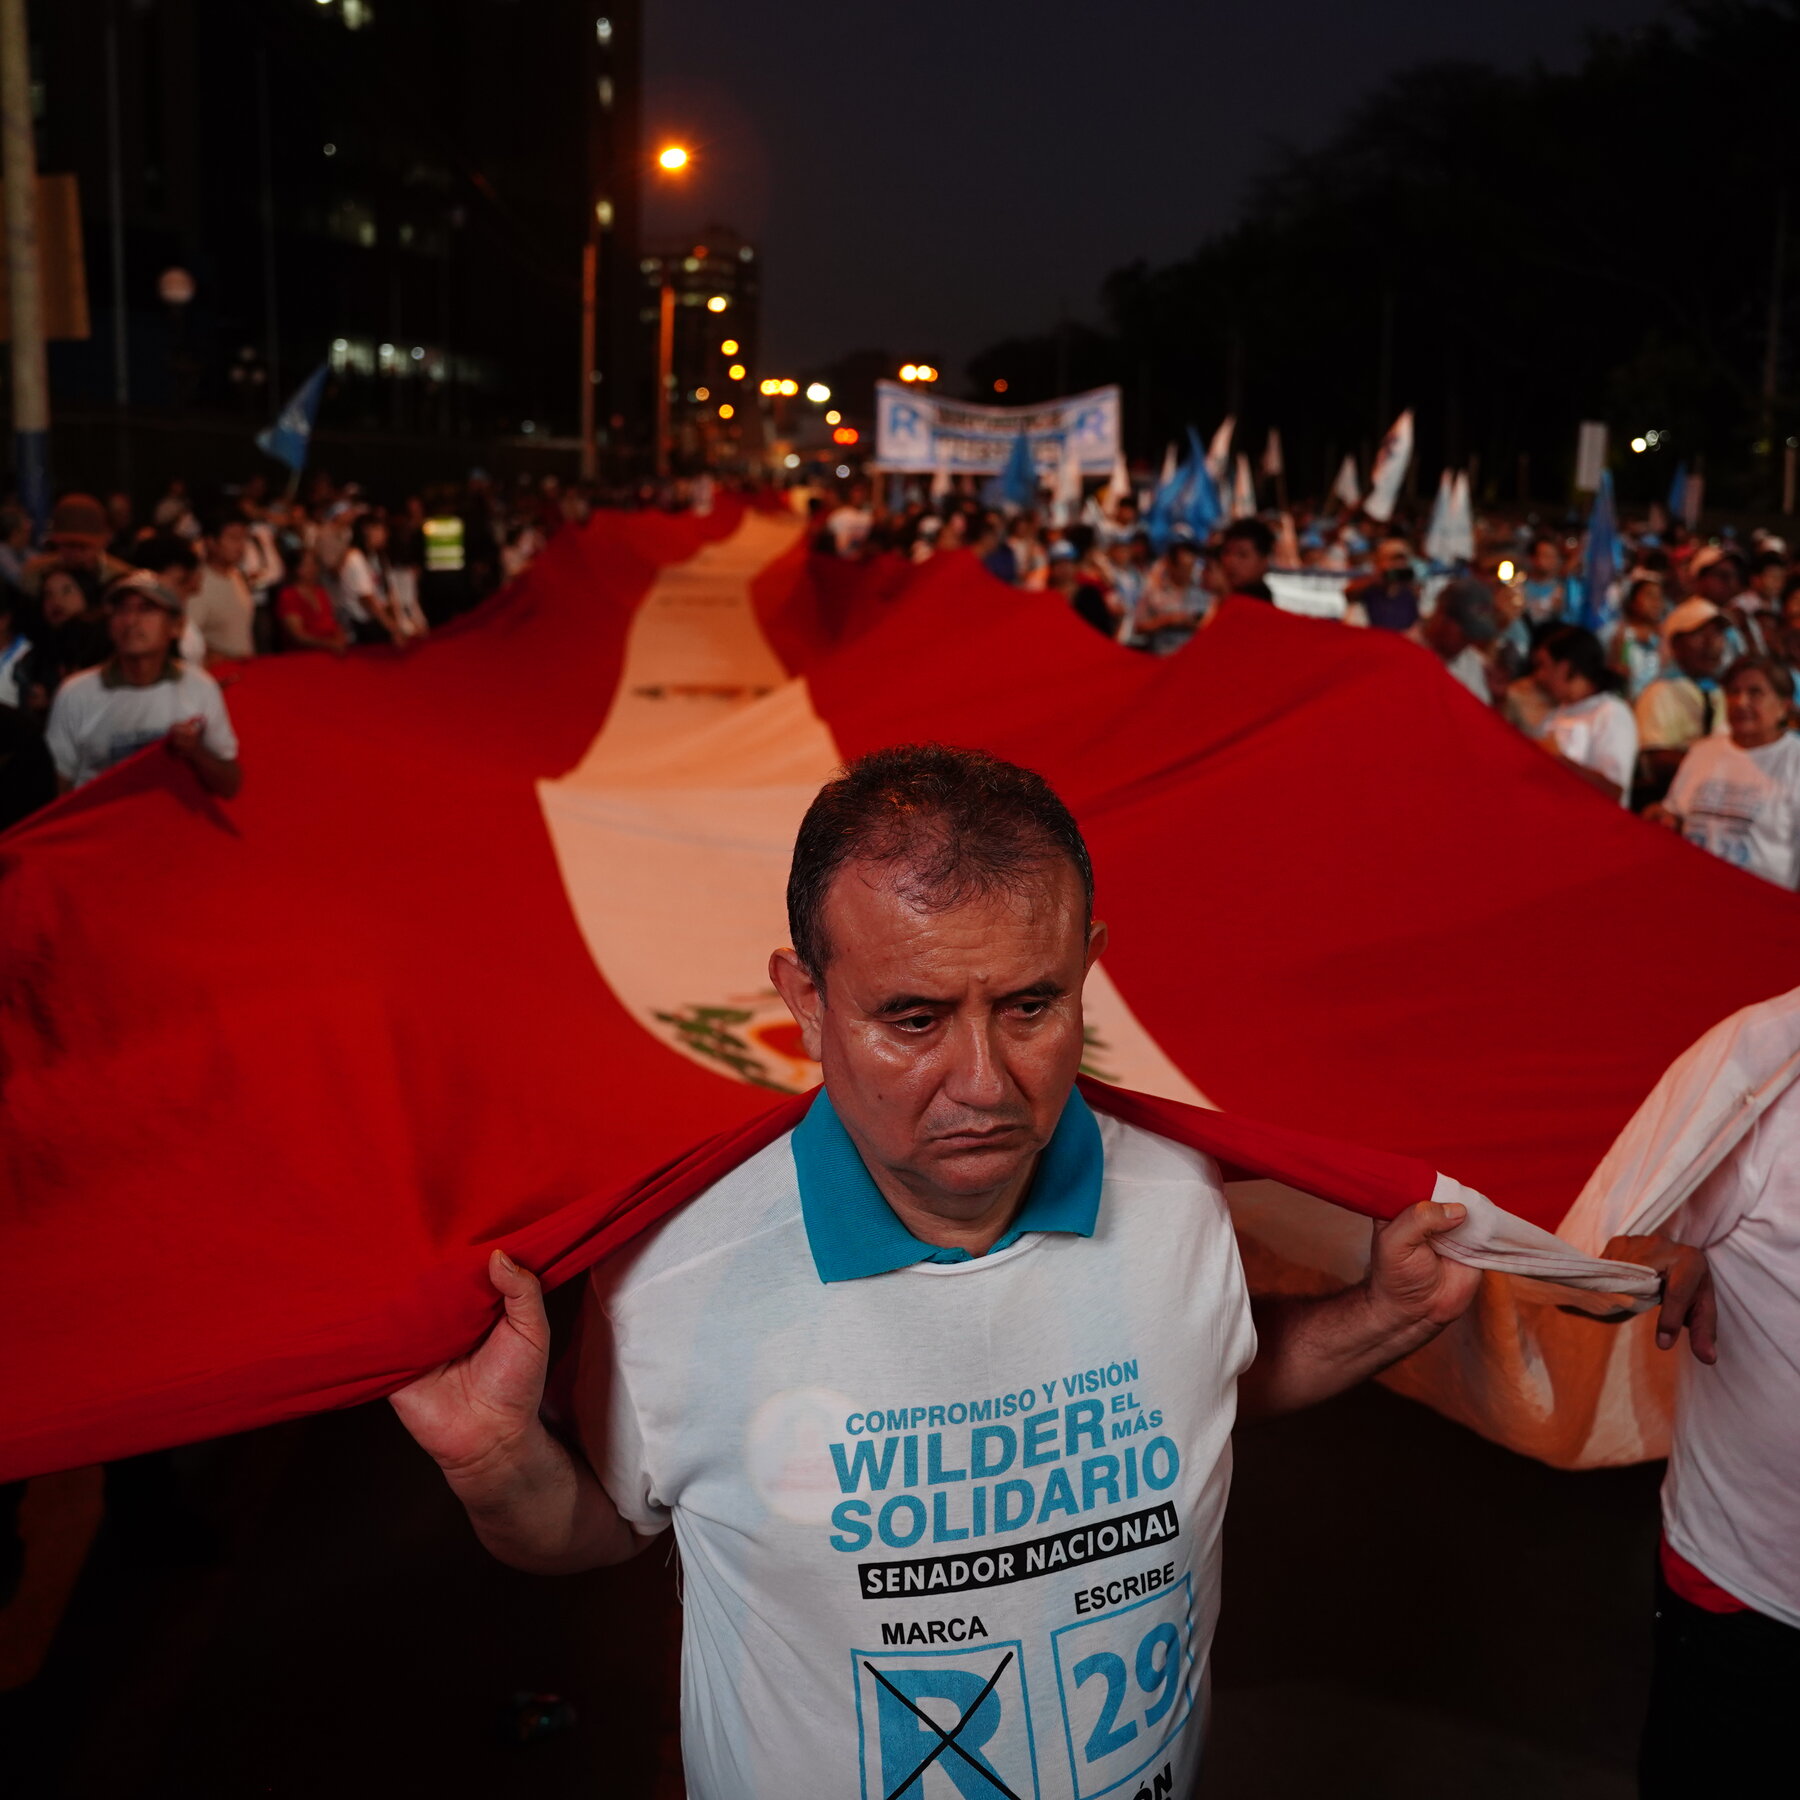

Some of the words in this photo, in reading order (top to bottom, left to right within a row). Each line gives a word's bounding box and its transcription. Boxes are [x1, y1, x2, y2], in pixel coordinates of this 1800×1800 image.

[890, 402, 920, 437] R
[1075, 406, 1107, 438] R
[846, 1389, 1036, 1435] COMPROMISO
[1042, 1380, 1057, 1404] Y
[1063, 1359, 1139, 1398] VISIÓN
[1110, 1392, 1141, 1414] EL
[1111, 1409, 1163, 1441] MÁS
[829, 1399, 1106, 1493] WILDER
[829, 1435, 1180, 1553] SOLIDARIO
[866, 1552, 1015, 1594] SENADOR
[1026, 1509, 1176, 1573] NACIONAL
[1074, 1562, 1175, 1615] ESCRIBE
[881, 1615, 989, 1645] MARCA
[1073, 1622, 1182, 1763] 29
[875, 1669, 1018, 1800] R
